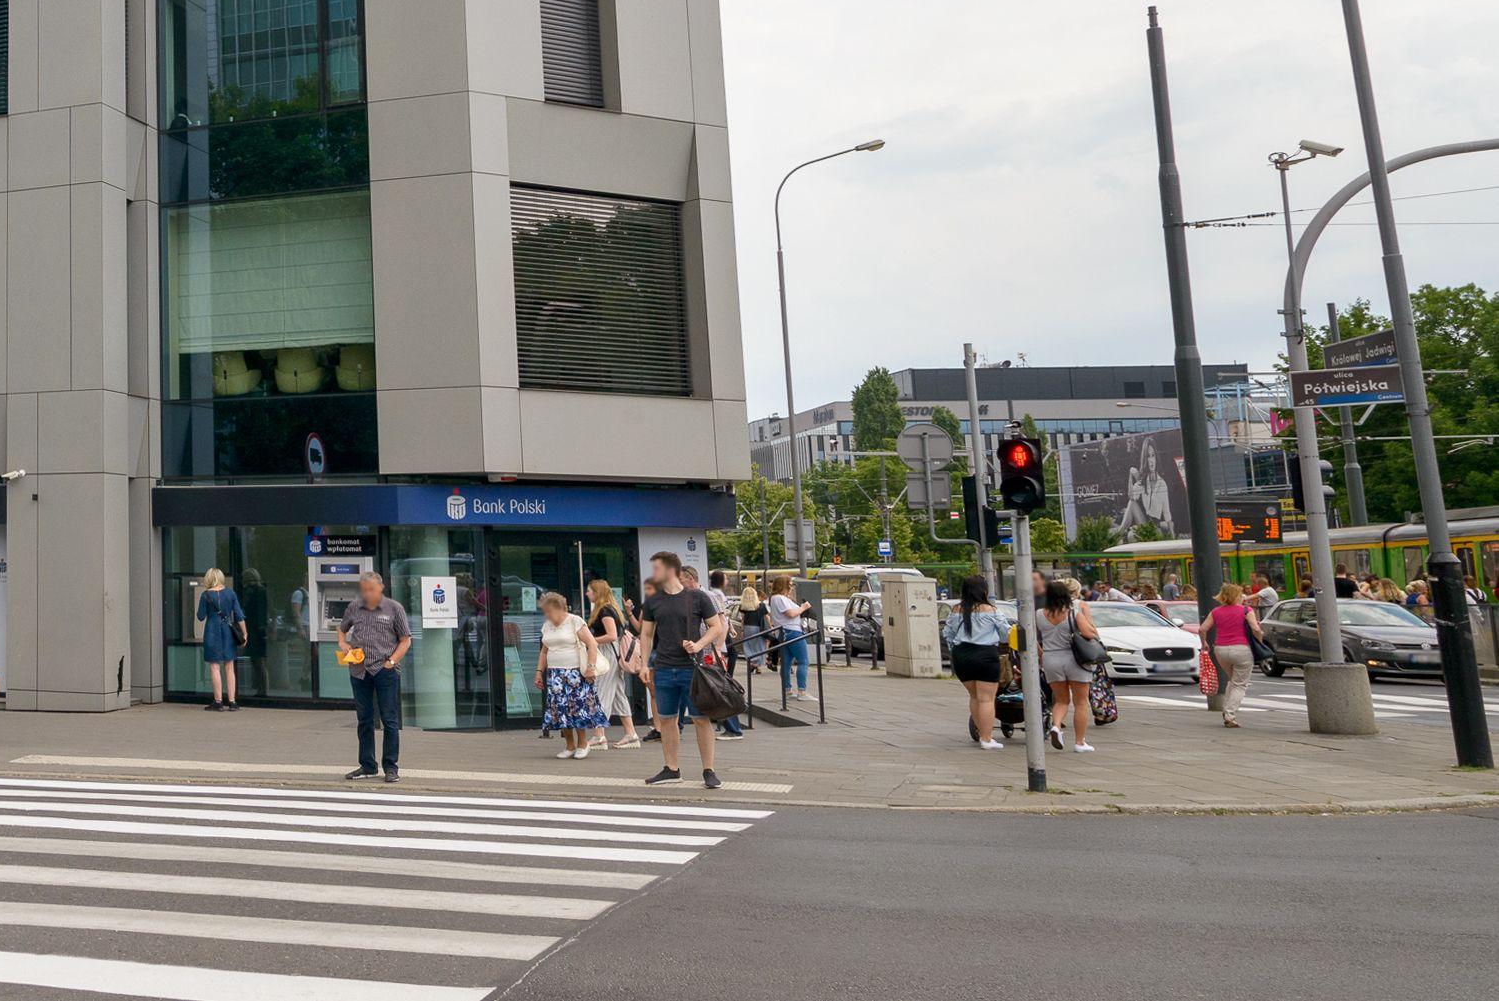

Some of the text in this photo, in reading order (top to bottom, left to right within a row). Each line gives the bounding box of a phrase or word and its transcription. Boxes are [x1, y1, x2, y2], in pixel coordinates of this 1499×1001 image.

[1365, 341, 1395, 359] Jadwigi
[1333, 371, 1354, 379] ulica
[1304, 379, 1389, 395] Półwiejska
[473, 498, 506, 514] Bank
[509, 498, 546, 514] Polski
[326, 545, 363, 554] wpłatomat
